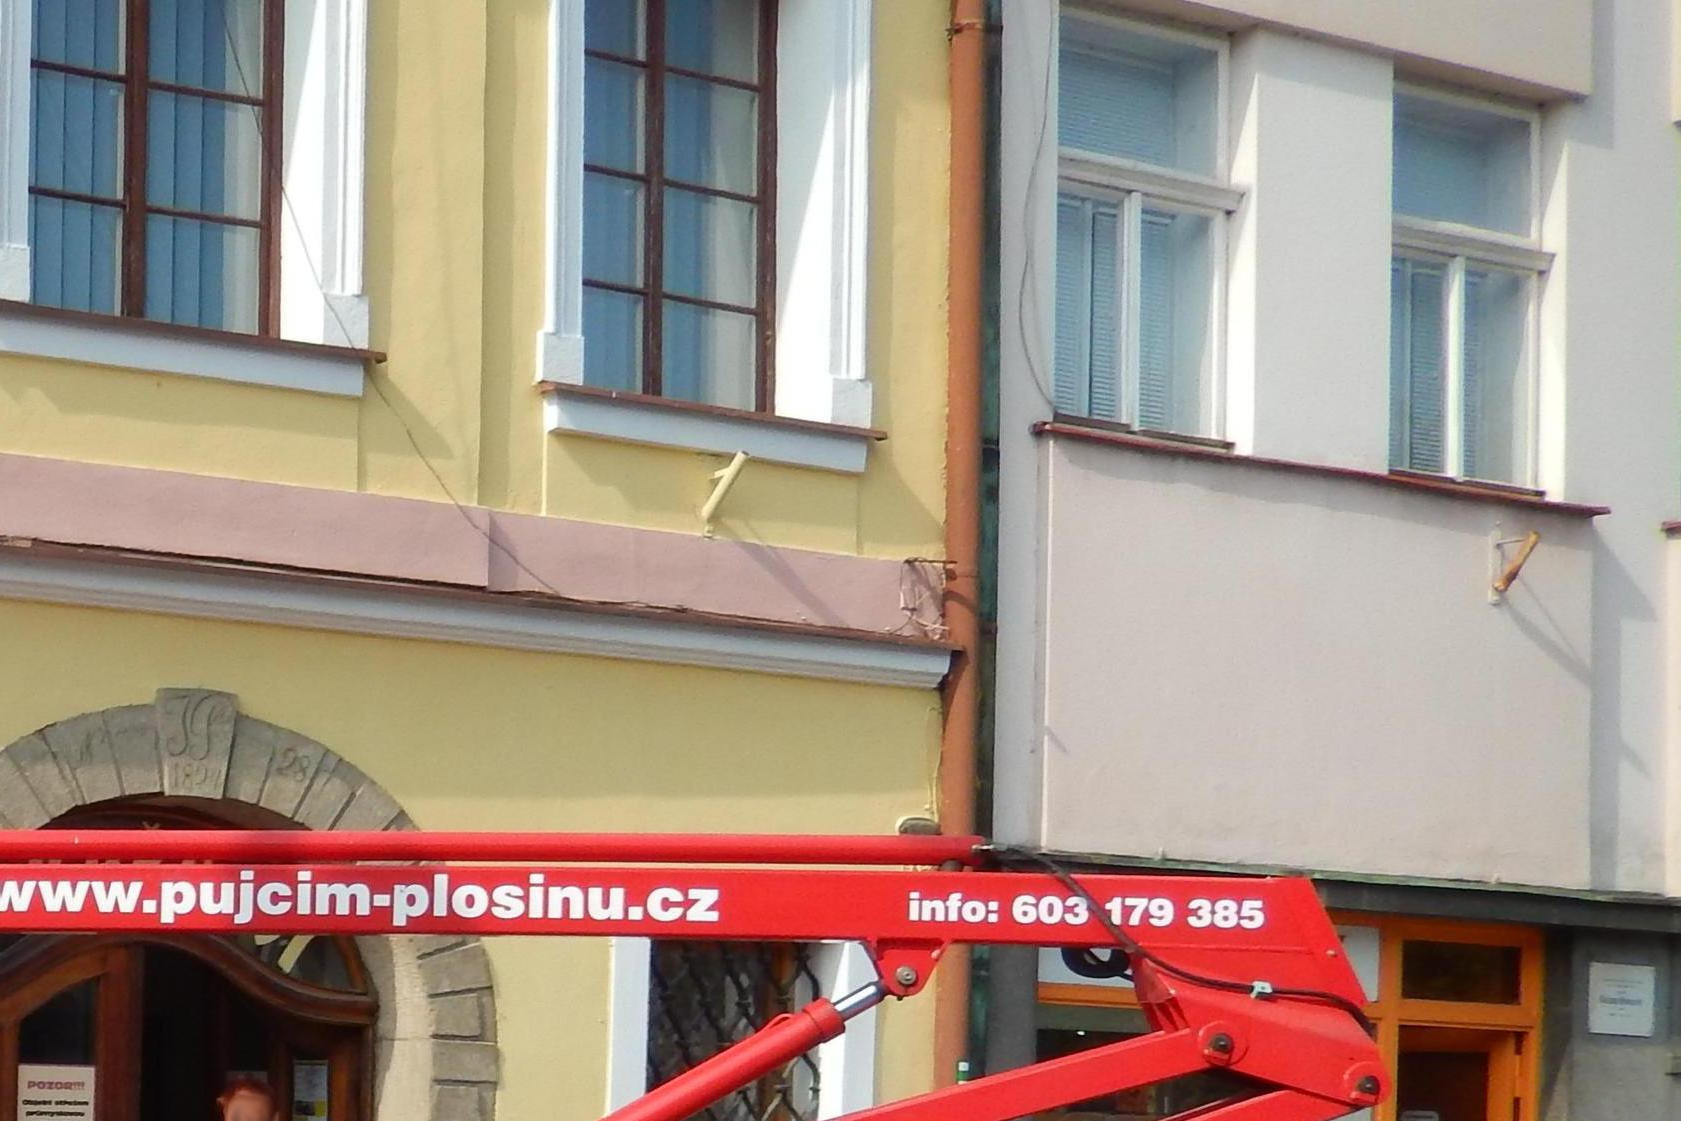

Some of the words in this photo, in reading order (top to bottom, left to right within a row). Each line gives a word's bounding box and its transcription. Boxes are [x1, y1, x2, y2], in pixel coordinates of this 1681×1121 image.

[908, 892, 999, 924] info:
[1012, 895, 1090, 926] 603
[1105, 896, 1174, 927] 179
[1188, 898, 1265, 929] 385
